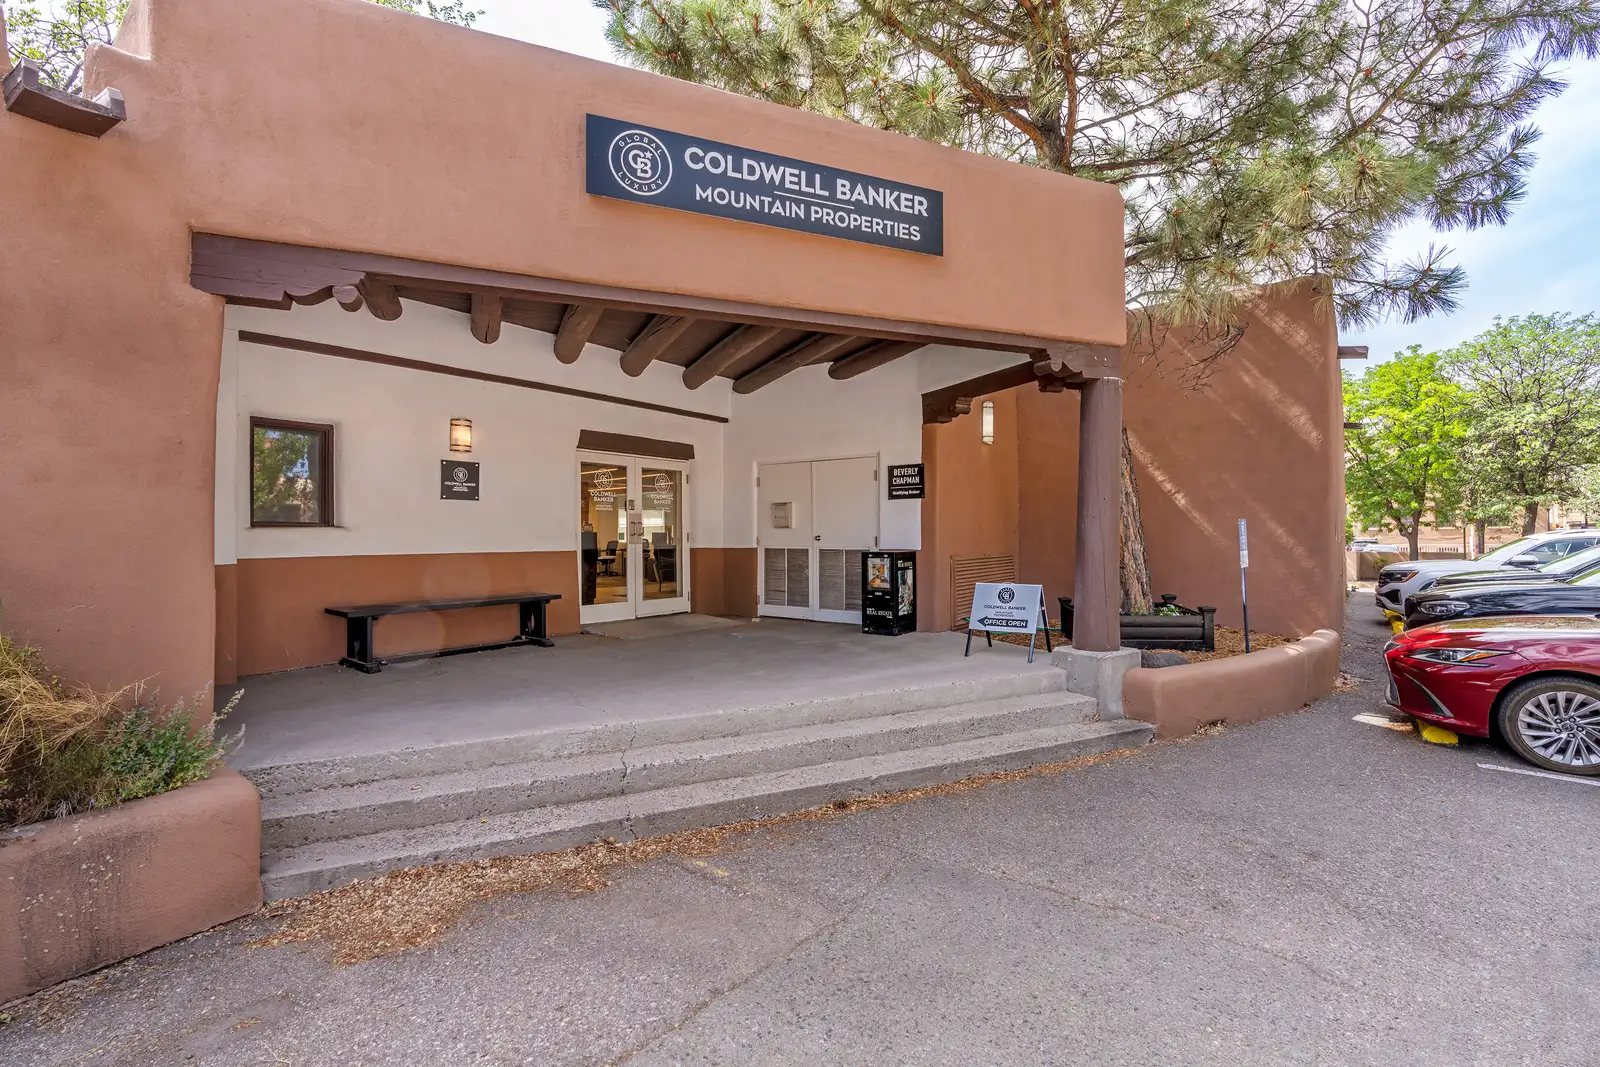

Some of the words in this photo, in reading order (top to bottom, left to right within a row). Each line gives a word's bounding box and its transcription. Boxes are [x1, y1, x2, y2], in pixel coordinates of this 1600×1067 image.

[618, 135, 662, 155] GLOBAL
[617, 171, 663, 191] LUXURY
[684, 147, 829, 196] COLDWELL
[836, 178, 928, 217] BANKER
[695, 184, 805, 220] MOUNTAIN
[810, 206, 921, 241] PROPERTIES
[892, 476, 920, 485] CHAPMAN
[893, 467, 919, 476] BEVERLY
